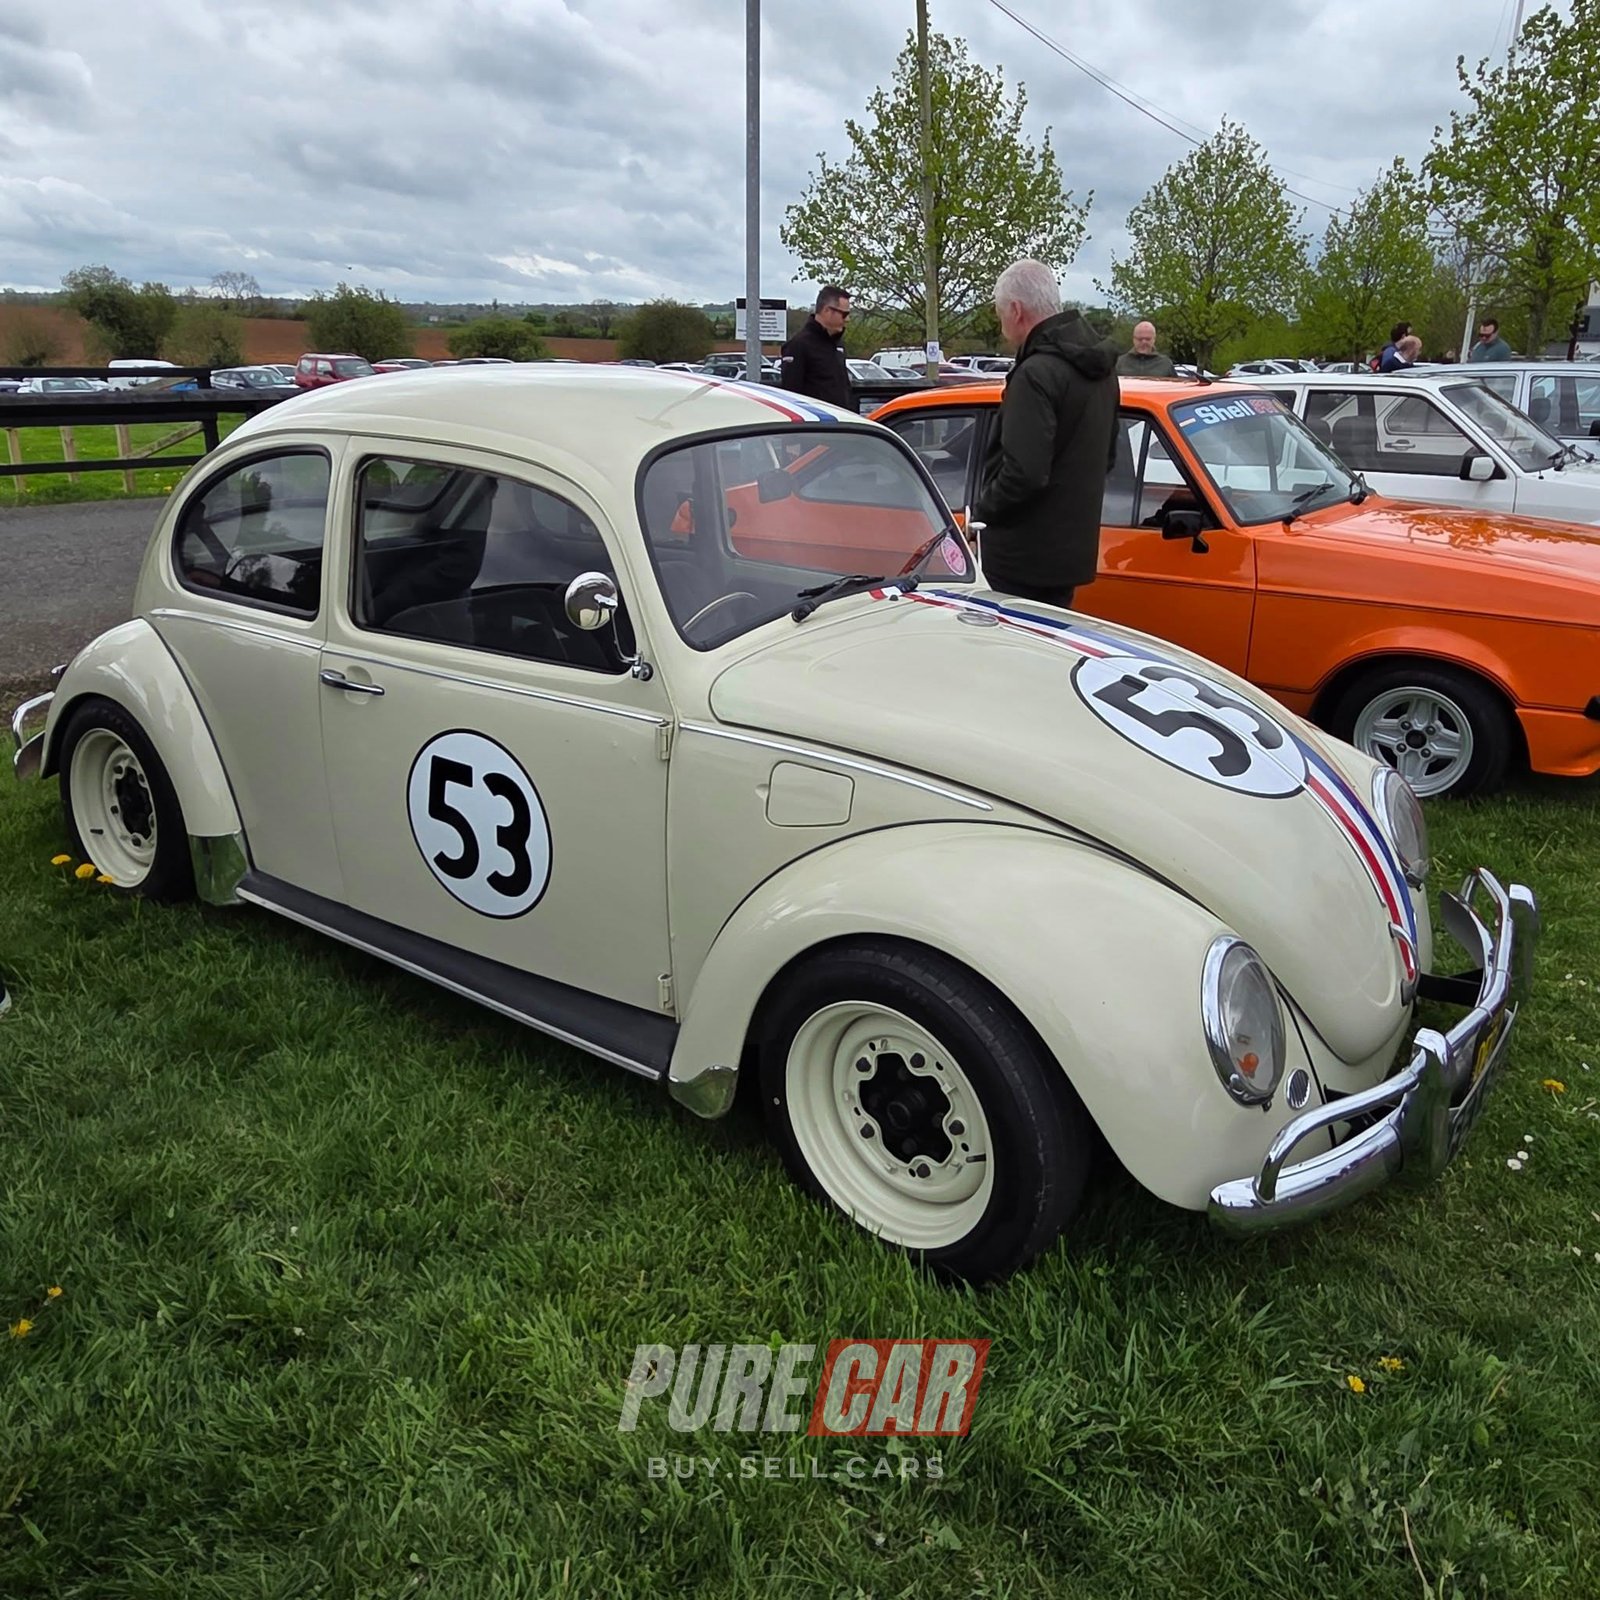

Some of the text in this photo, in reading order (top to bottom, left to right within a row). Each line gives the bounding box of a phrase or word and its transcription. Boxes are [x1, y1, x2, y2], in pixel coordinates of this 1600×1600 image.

[1194, 400, 1255, 425] Shell
[1092, 666, 1284, 777] 53
[428, 754, 533, 898] 53
